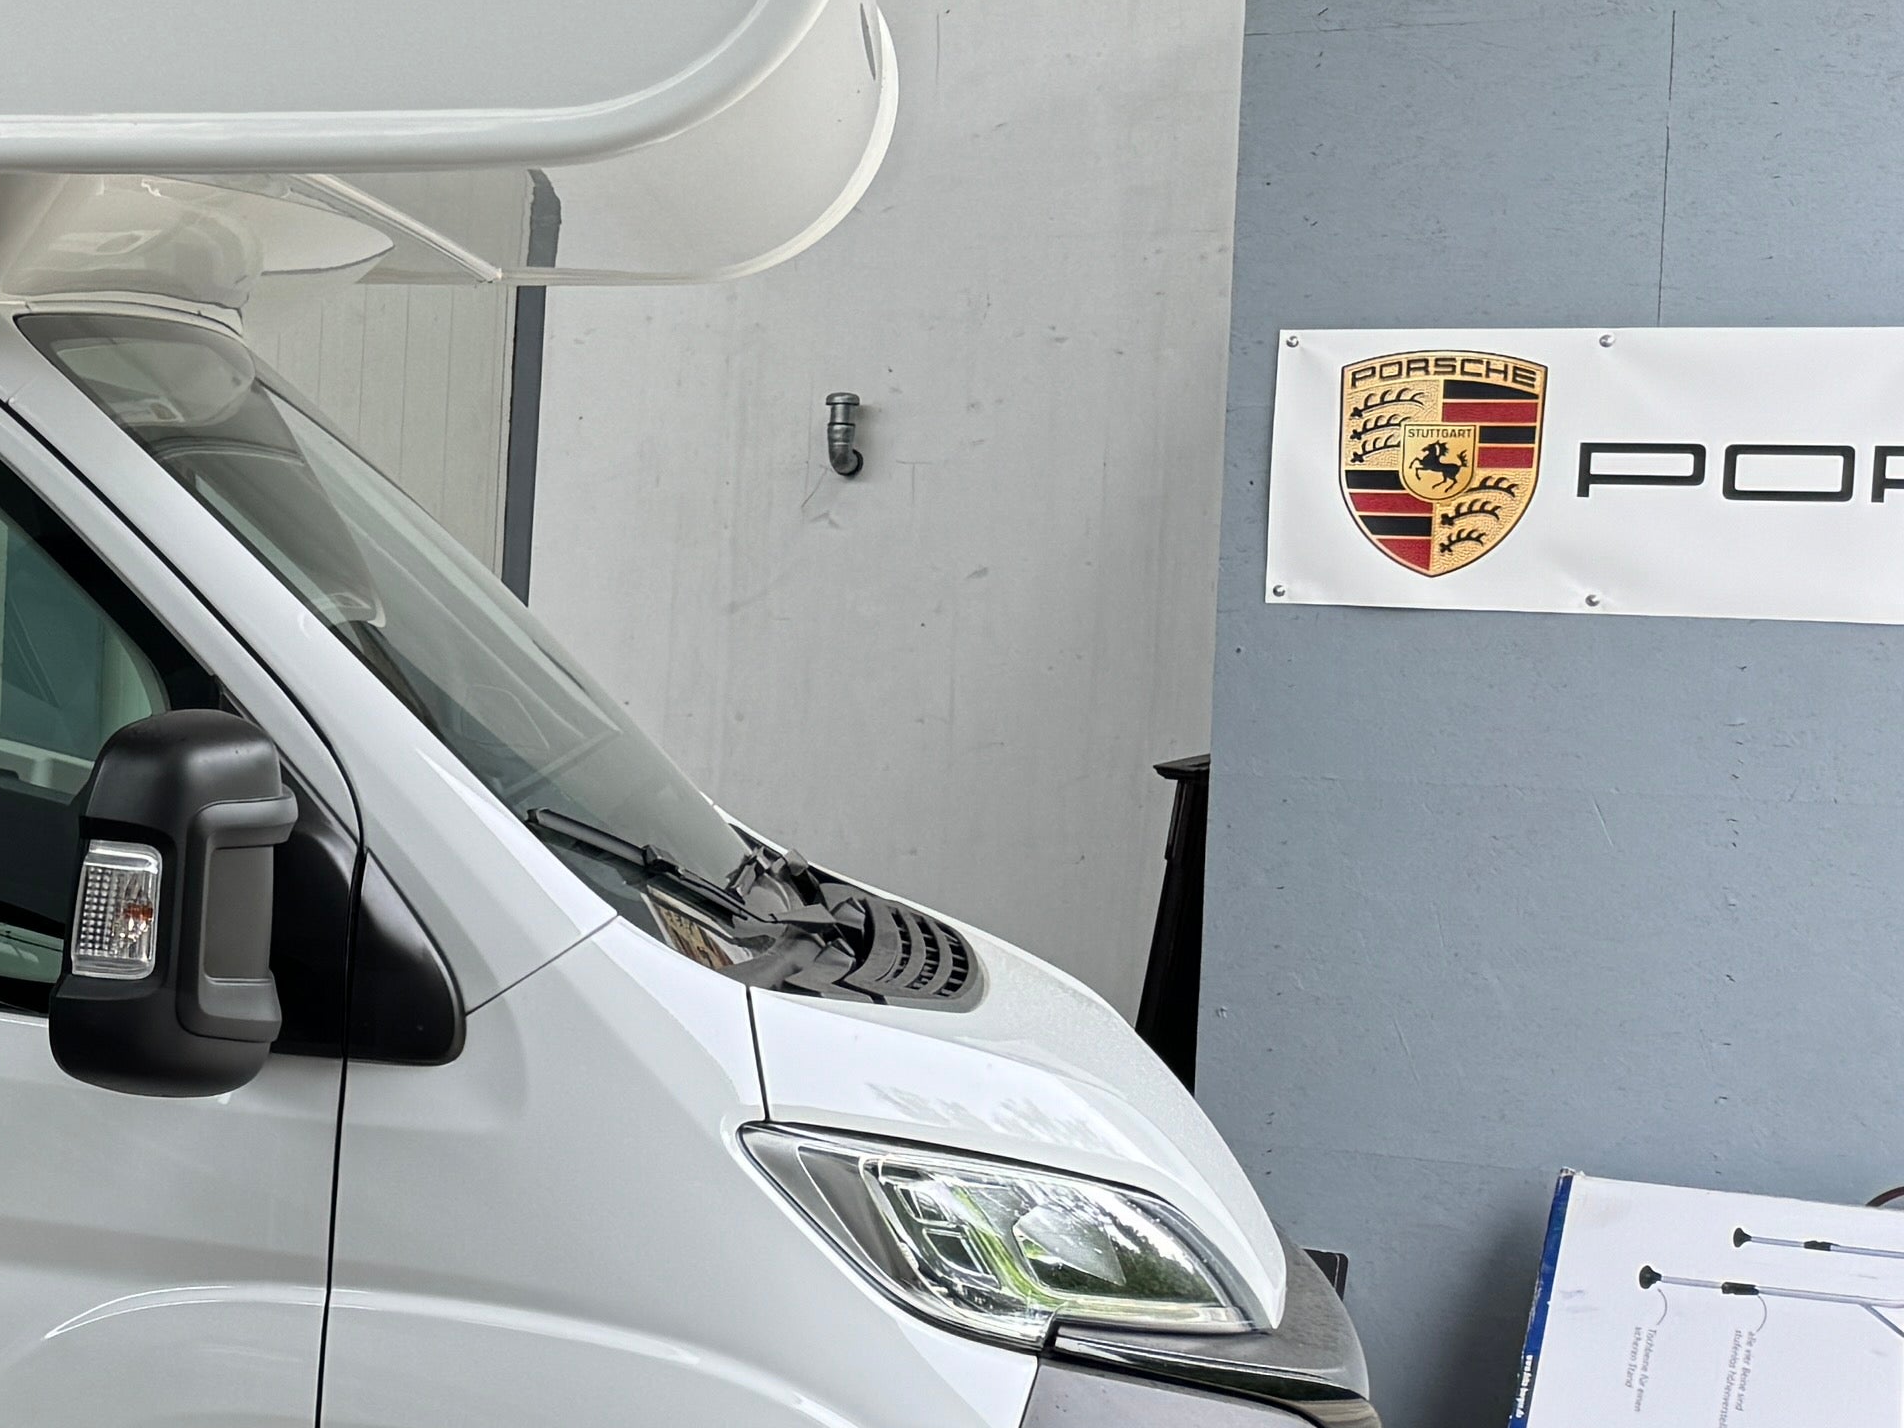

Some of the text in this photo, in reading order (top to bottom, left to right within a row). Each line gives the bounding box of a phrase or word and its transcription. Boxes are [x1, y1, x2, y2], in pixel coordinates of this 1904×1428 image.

[1351, 357, 1537, 389] PORSCHE
[1407, 428, 1472, 439] STUTTGART
[1576, 443, 1904, 502] PO
